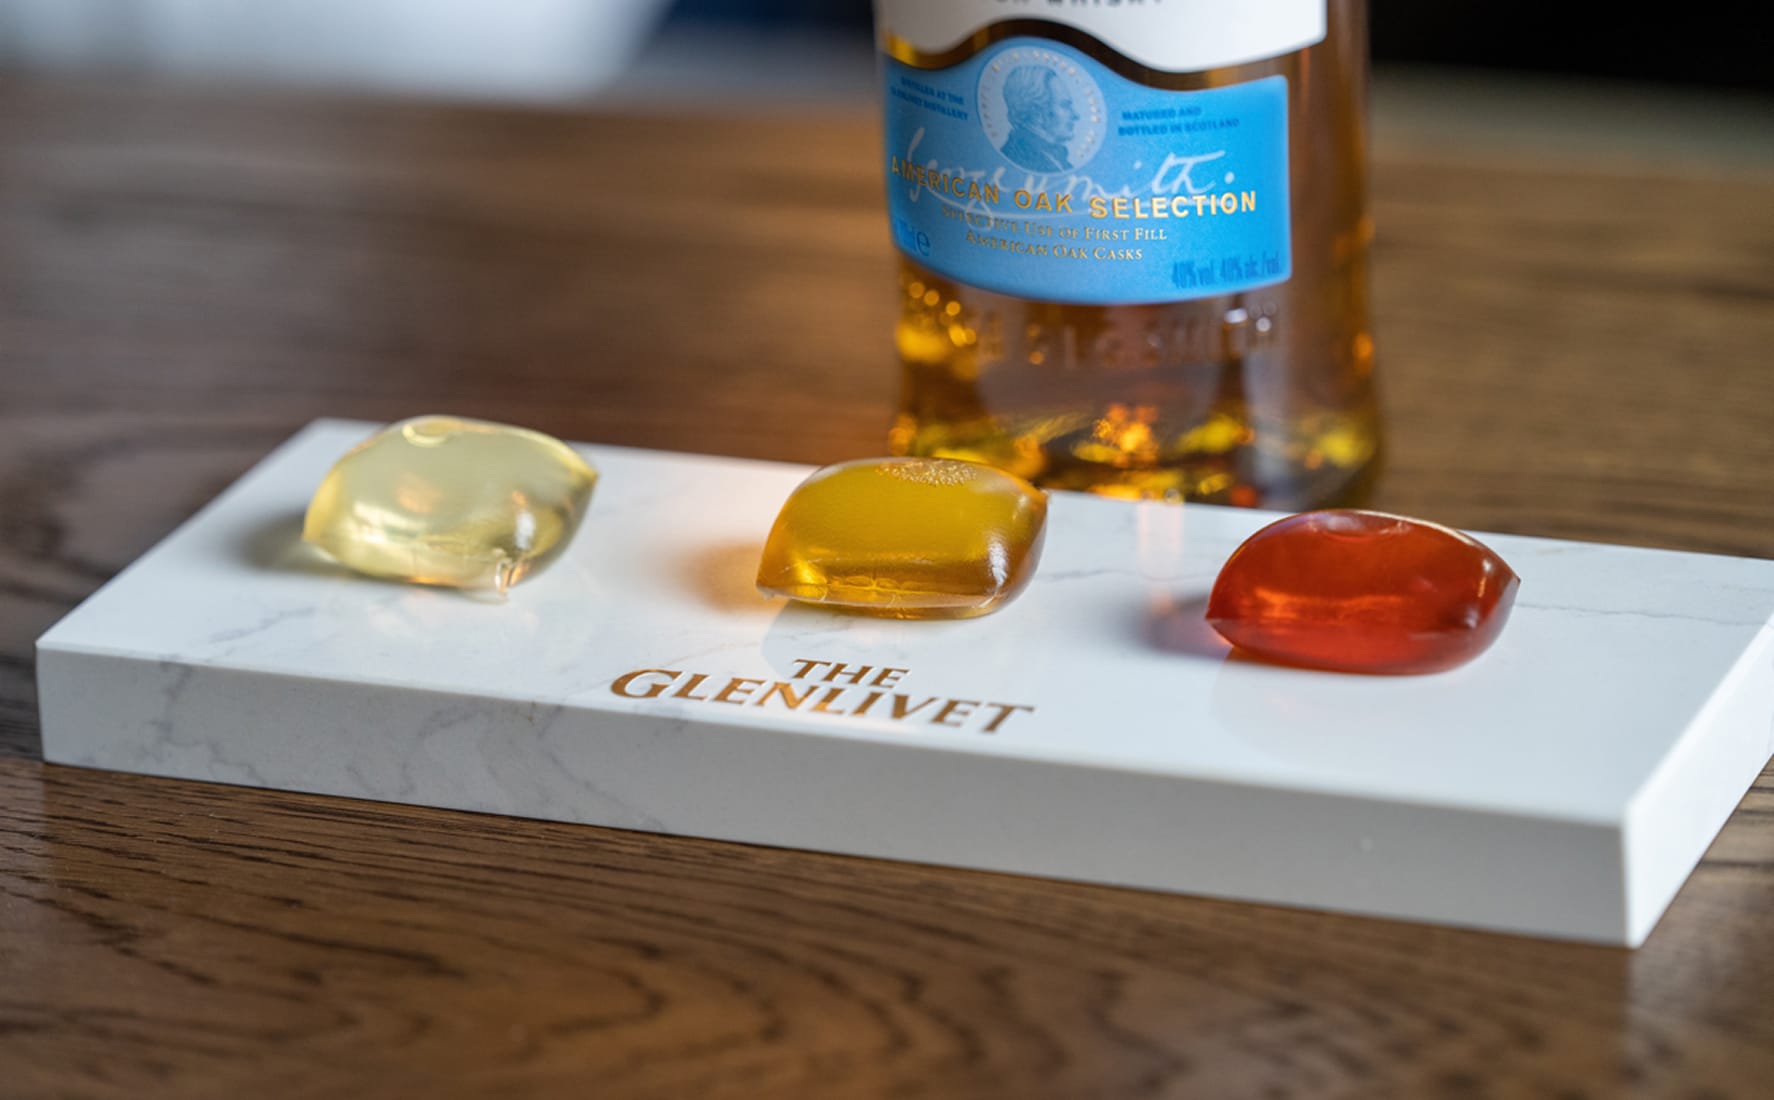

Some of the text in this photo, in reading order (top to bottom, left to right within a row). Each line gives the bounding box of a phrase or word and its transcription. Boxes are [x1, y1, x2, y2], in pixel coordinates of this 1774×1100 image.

[1179, 105, 1202, 117] AND
[1118, 123, 1168, 136] BOTTLED
[1184, 118, 1240, 132] SCOTLAND
[891, 155, 1257, 219] AMERICAN OAK SELECTION
[1085, 227, 1129, 241] FIRST
[1133, 227, 1169, 241] FILL
[1052, 245, 1089, 260] OAK
[1093, 246, 1143, 261] CASKS
[791, 658, 912, 690] THE
[609, 668, 1036, 735] GLENLIVET
